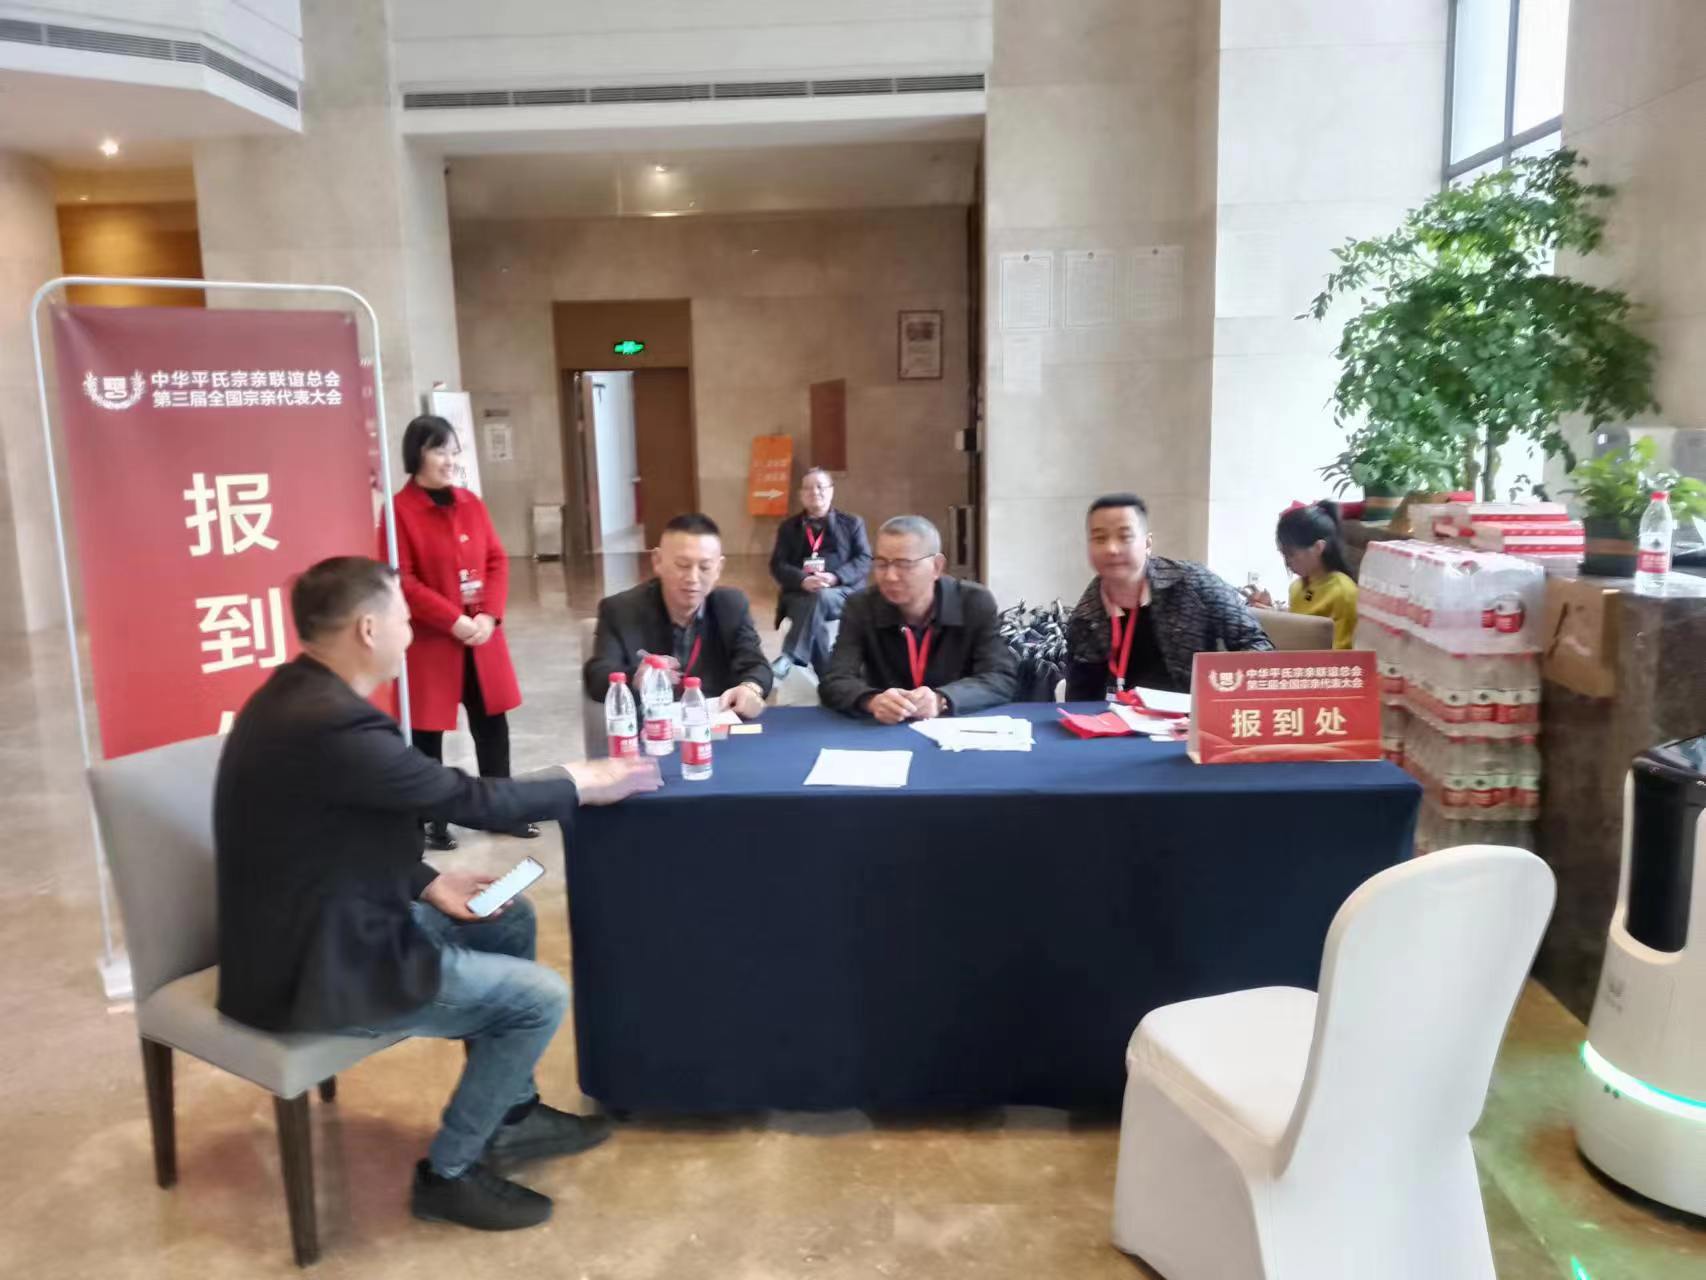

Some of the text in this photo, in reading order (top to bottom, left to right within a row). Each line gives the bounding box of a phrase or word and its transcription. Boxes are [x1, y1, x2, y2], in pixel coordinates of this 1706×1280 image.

[151, 369, 341, 389] 中华平氏宗亲联谊总会
[152, 388, 343, 408] 第三届全国宗亲代表大会
[182, 472, 287, 735] 报到
[1232, 707, 1347, 737] 报到处
